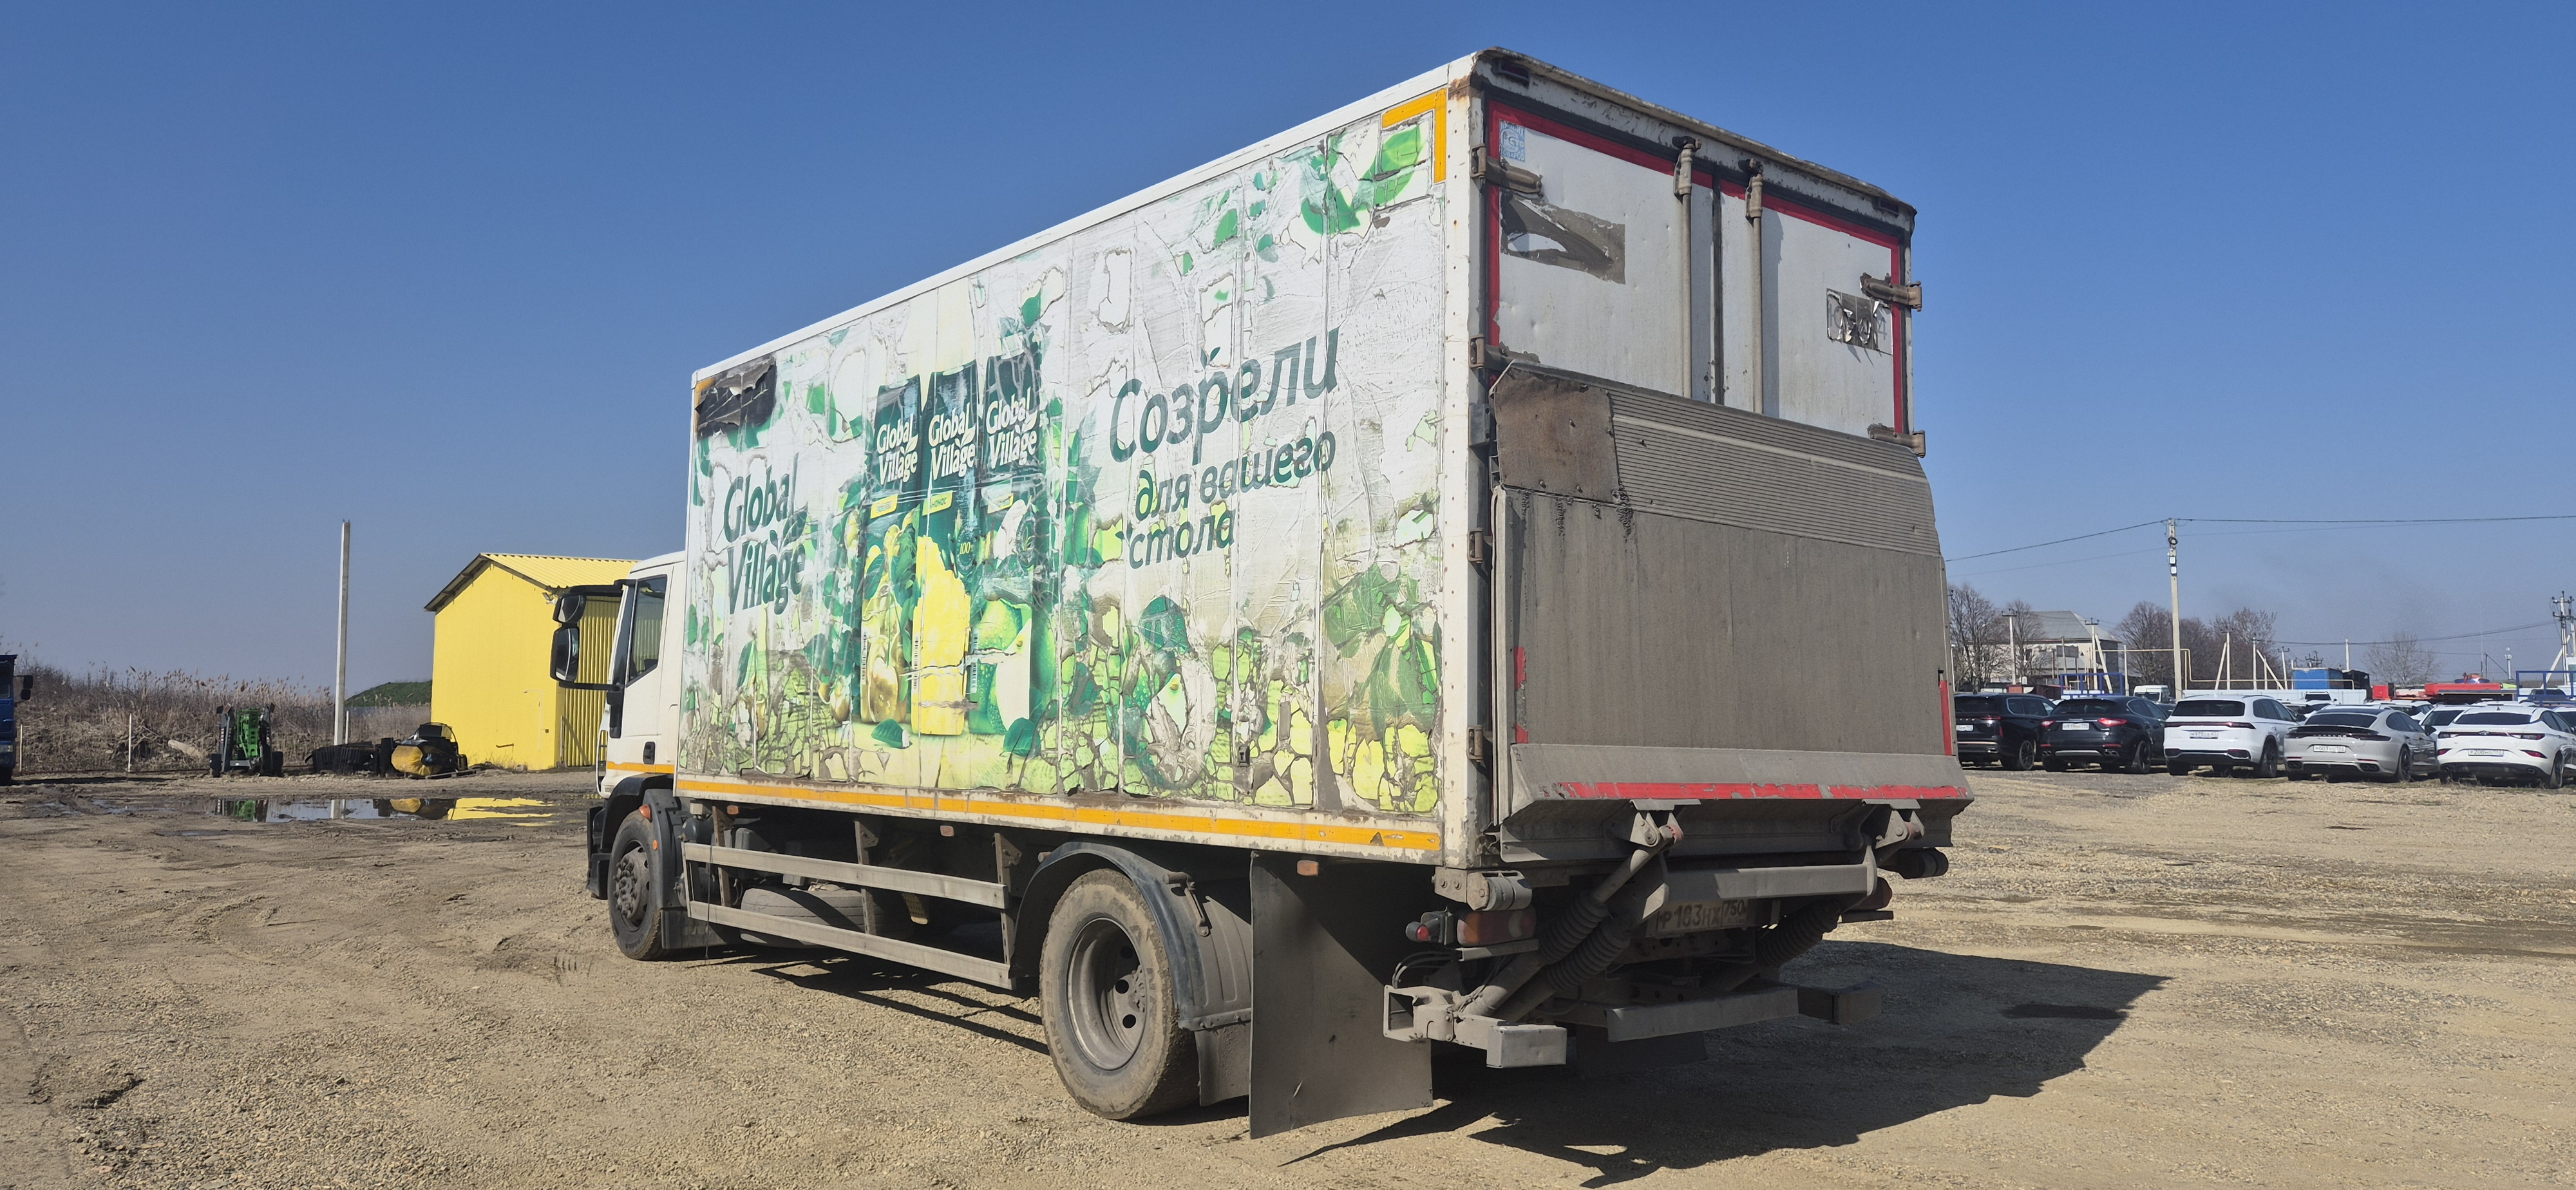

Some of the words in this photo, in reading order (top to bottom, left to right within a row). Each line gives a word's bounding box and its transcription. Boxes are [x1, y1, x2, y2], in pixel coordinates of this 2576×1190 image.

[986, 386, 1032, 434] Global
[1110, 326, 1340, 465] Созрели
[876, 413, 914, 454] Global
[929, 402, 971, 447] Global
[878, 450, 918, 485] Village
[931, 442, 976, 480] Village
[989, 430, 1037, 469] Village
[724, 452, 800, 543] Global
[1135, 470, 1192, 521] для
[1200, 431, 1336, 504] вашего
[1128, 509, 1236, 569] стола
[727, 540, 805, 615] Village
